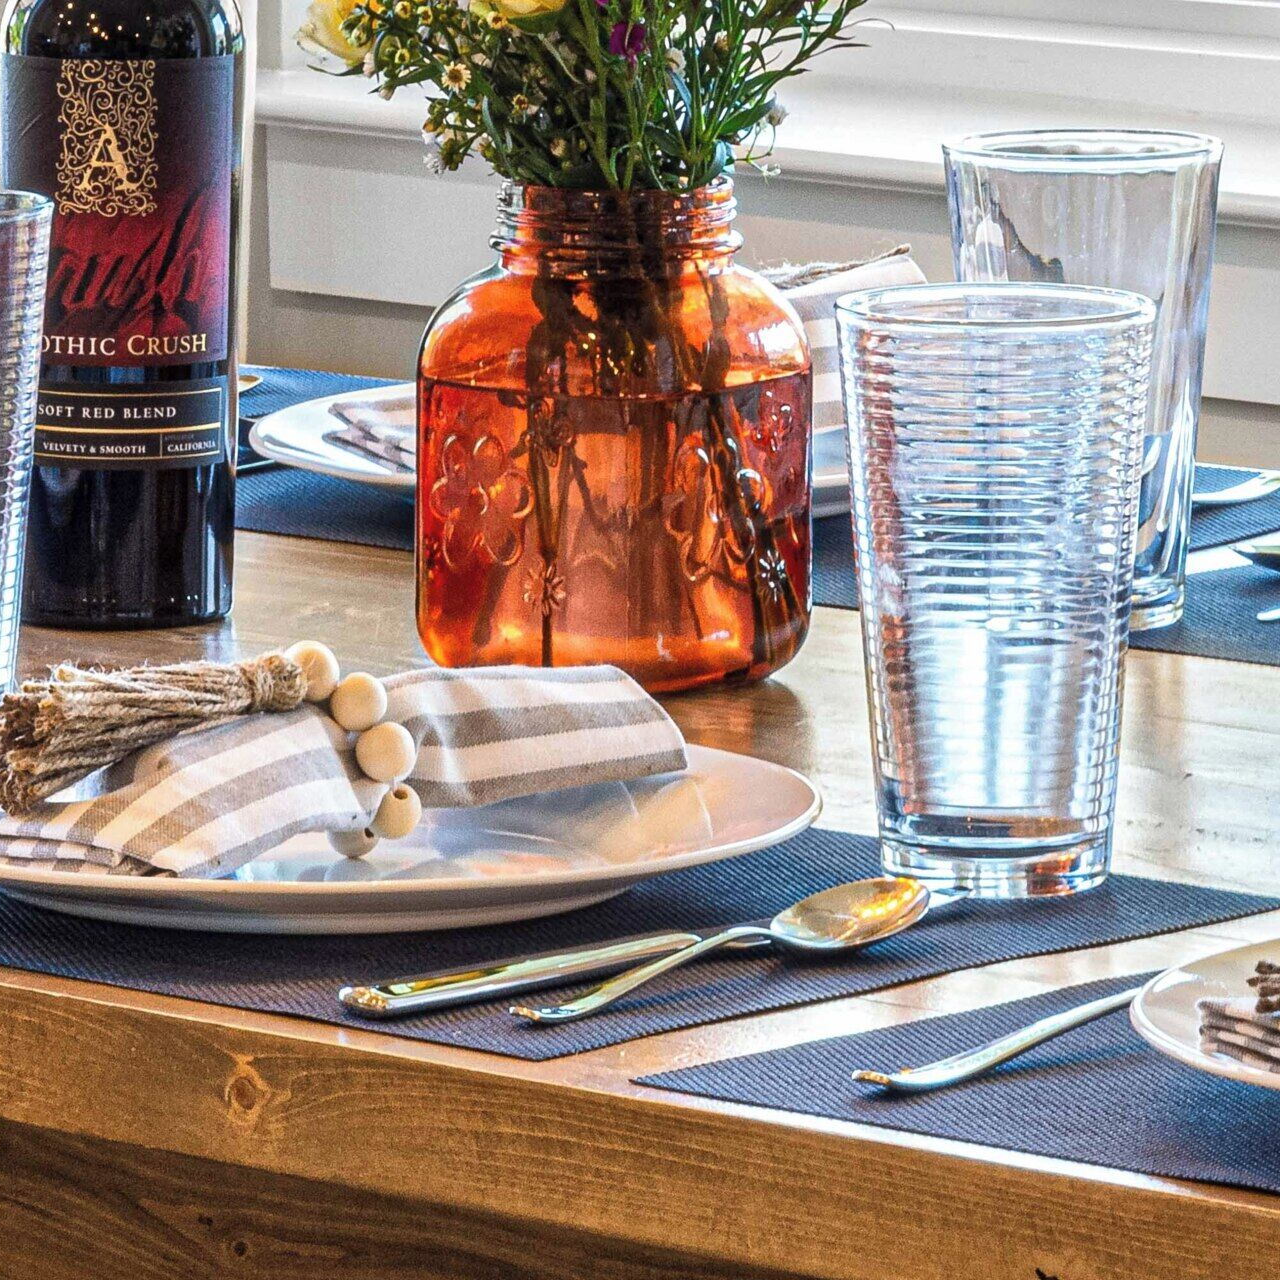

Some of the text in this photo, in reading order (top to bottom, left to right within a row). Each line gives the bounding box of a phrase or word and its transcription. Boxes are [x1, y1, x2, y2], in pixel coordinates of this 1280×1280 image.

[127, 333, 207, 356] CRUSH
[38, 404, 177, 419] SOFT RED BLEND
[43, 442, 147, 455] VELVETY & SMOOTH
[167, 440, 216, 452] CALIFORNIA
